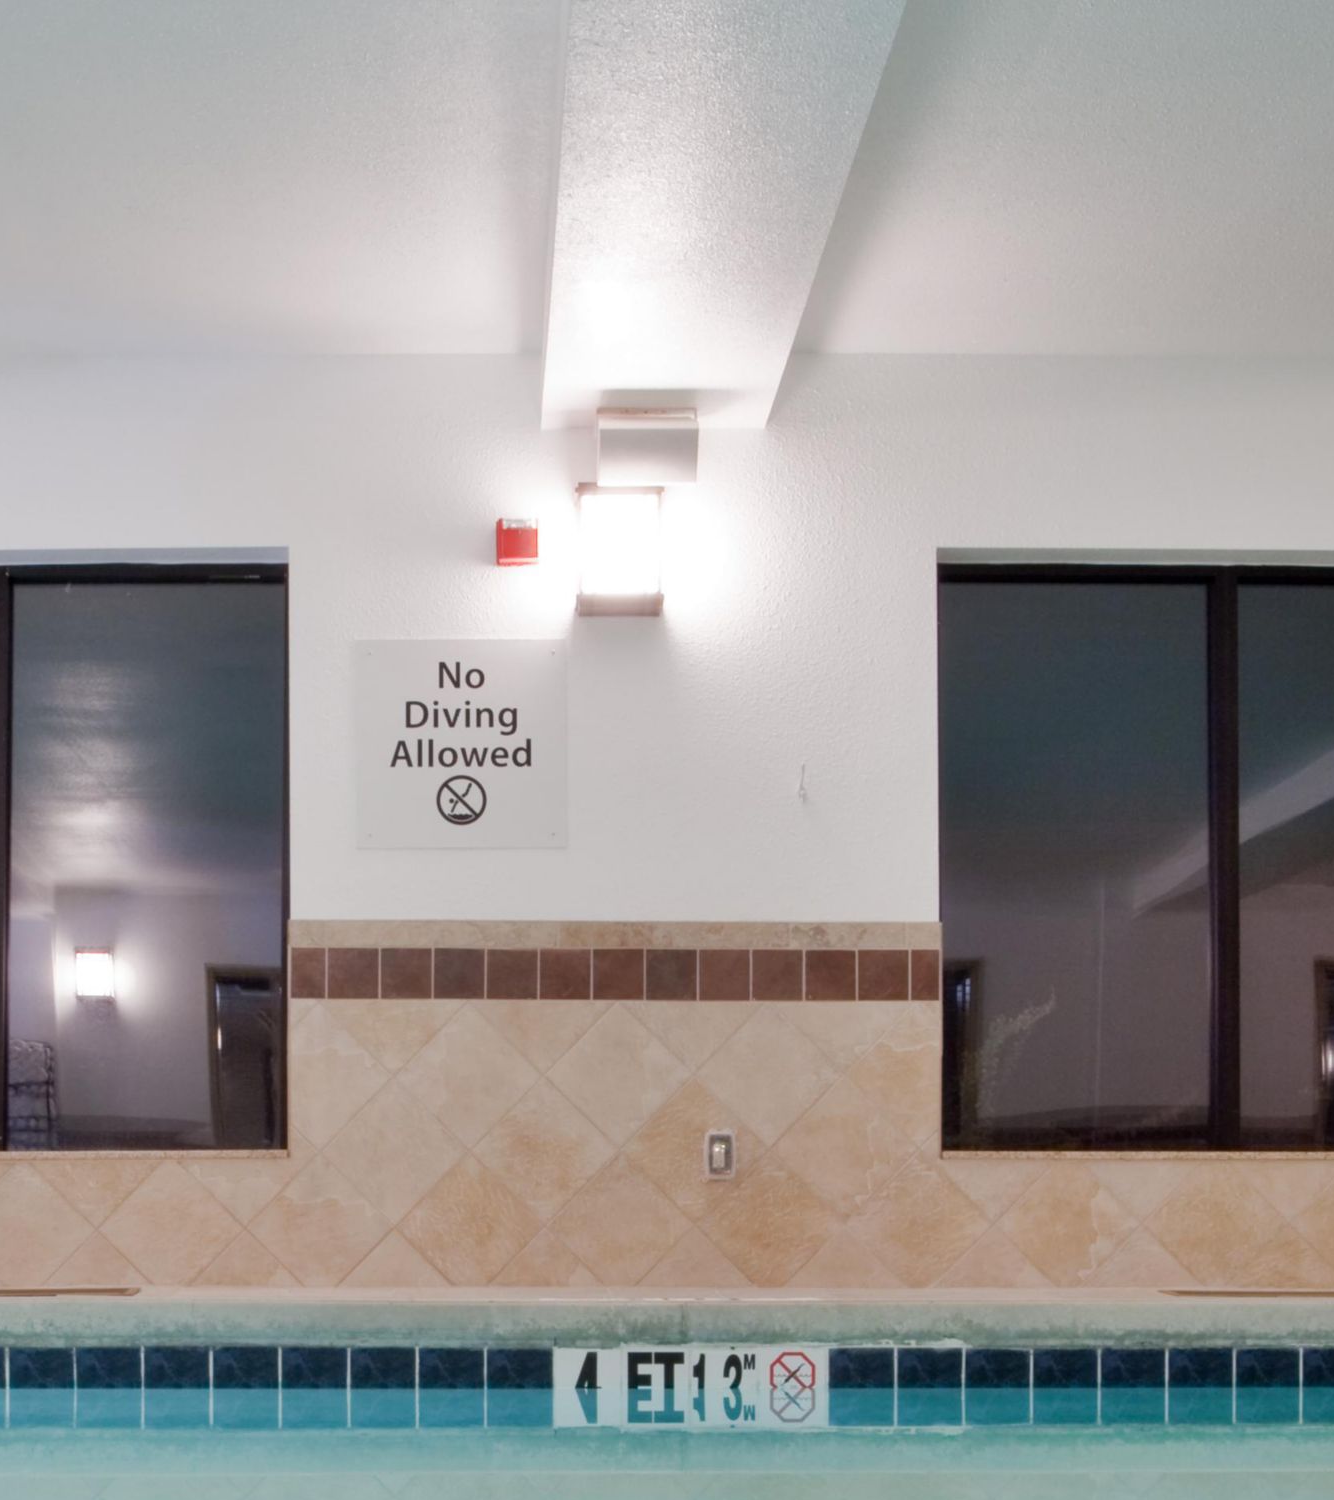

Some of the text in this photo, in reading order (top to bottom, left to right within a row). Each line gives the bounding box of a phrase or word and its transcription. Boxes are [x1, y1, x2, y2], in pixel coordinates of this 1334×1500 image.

[438, 661, 485, 689] No
[405, 700, 518, 736] Diving
[390, 738, 532, 768] Allowed
